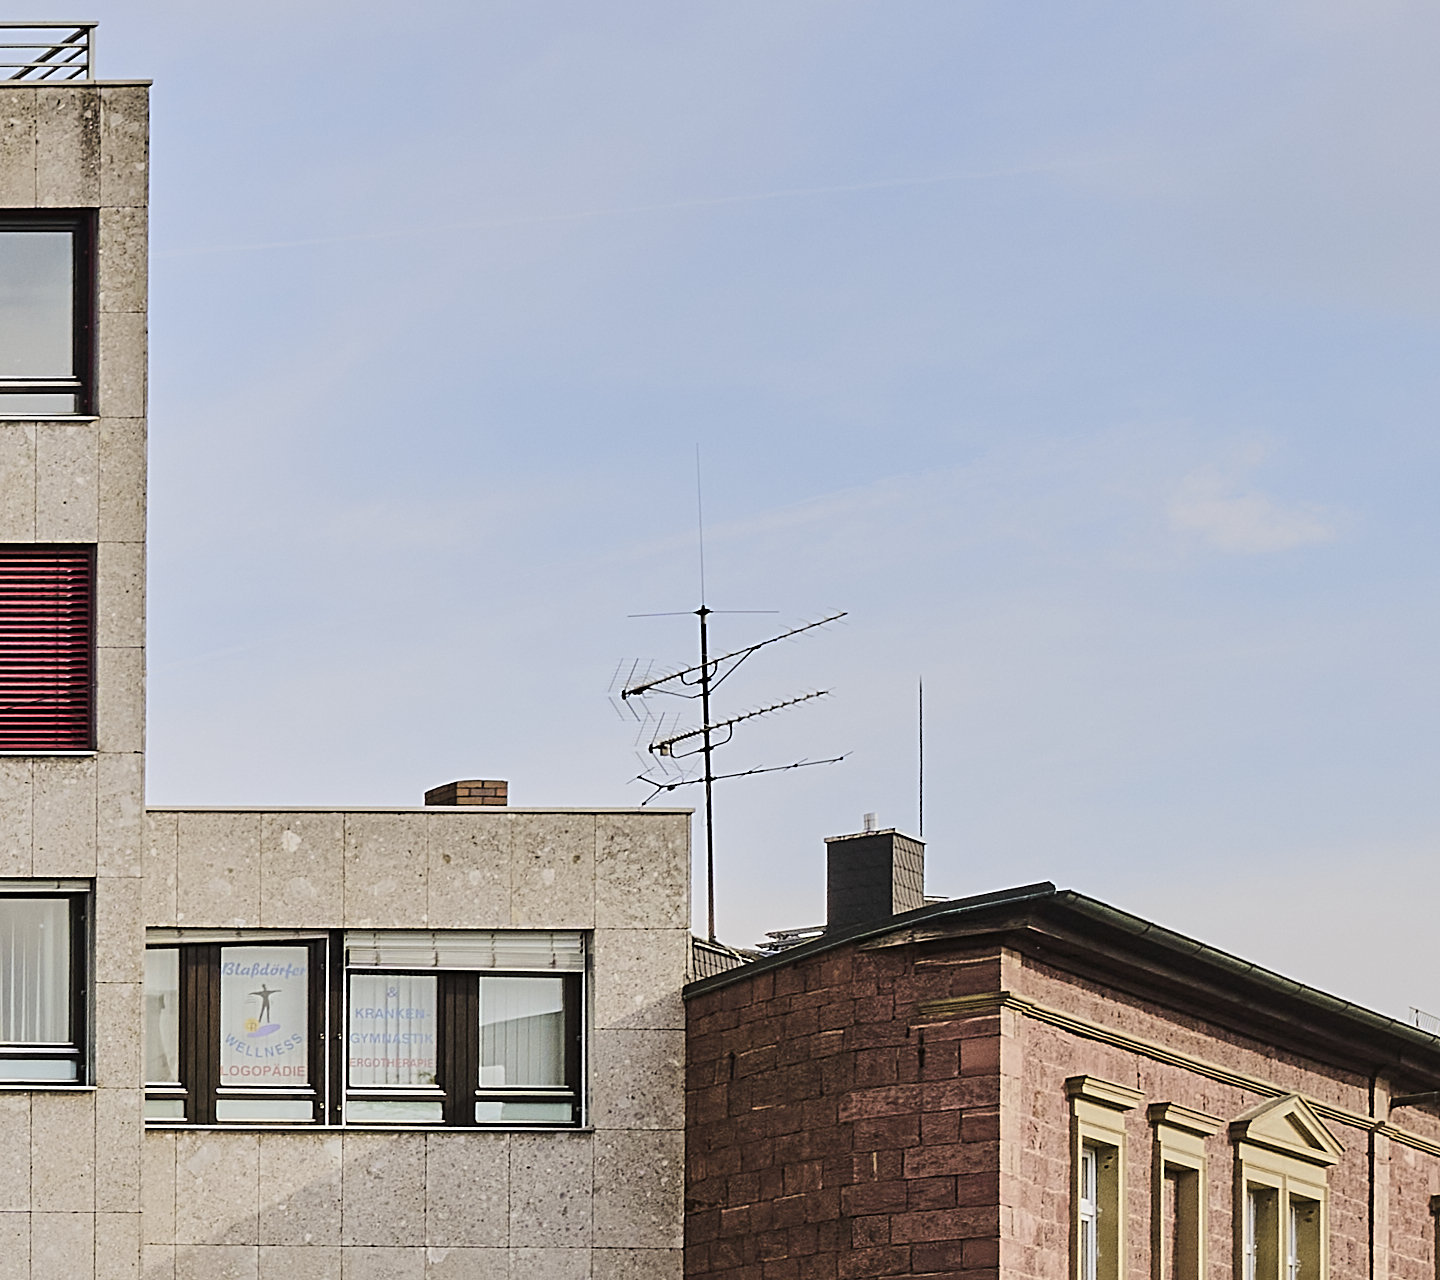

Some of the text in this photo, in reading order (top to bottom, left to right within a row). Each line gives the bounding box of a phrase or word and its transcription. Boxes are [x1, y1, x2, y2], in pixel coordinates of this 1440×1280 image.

[221, 962, 307, 979] Blaßdörfer
[386, 986, 398, 998] &
[355, 1008, 431, 1019] KRANKEN-
[350, 1033, 434, 1045] GYMNASTIK
[224, 1033, 303, 1058] WELLNESS
[349, 1058, 434, 1068] ERGOTHERAPIE
[220, 1063, 306, 1077] LOGOPÄDIE
